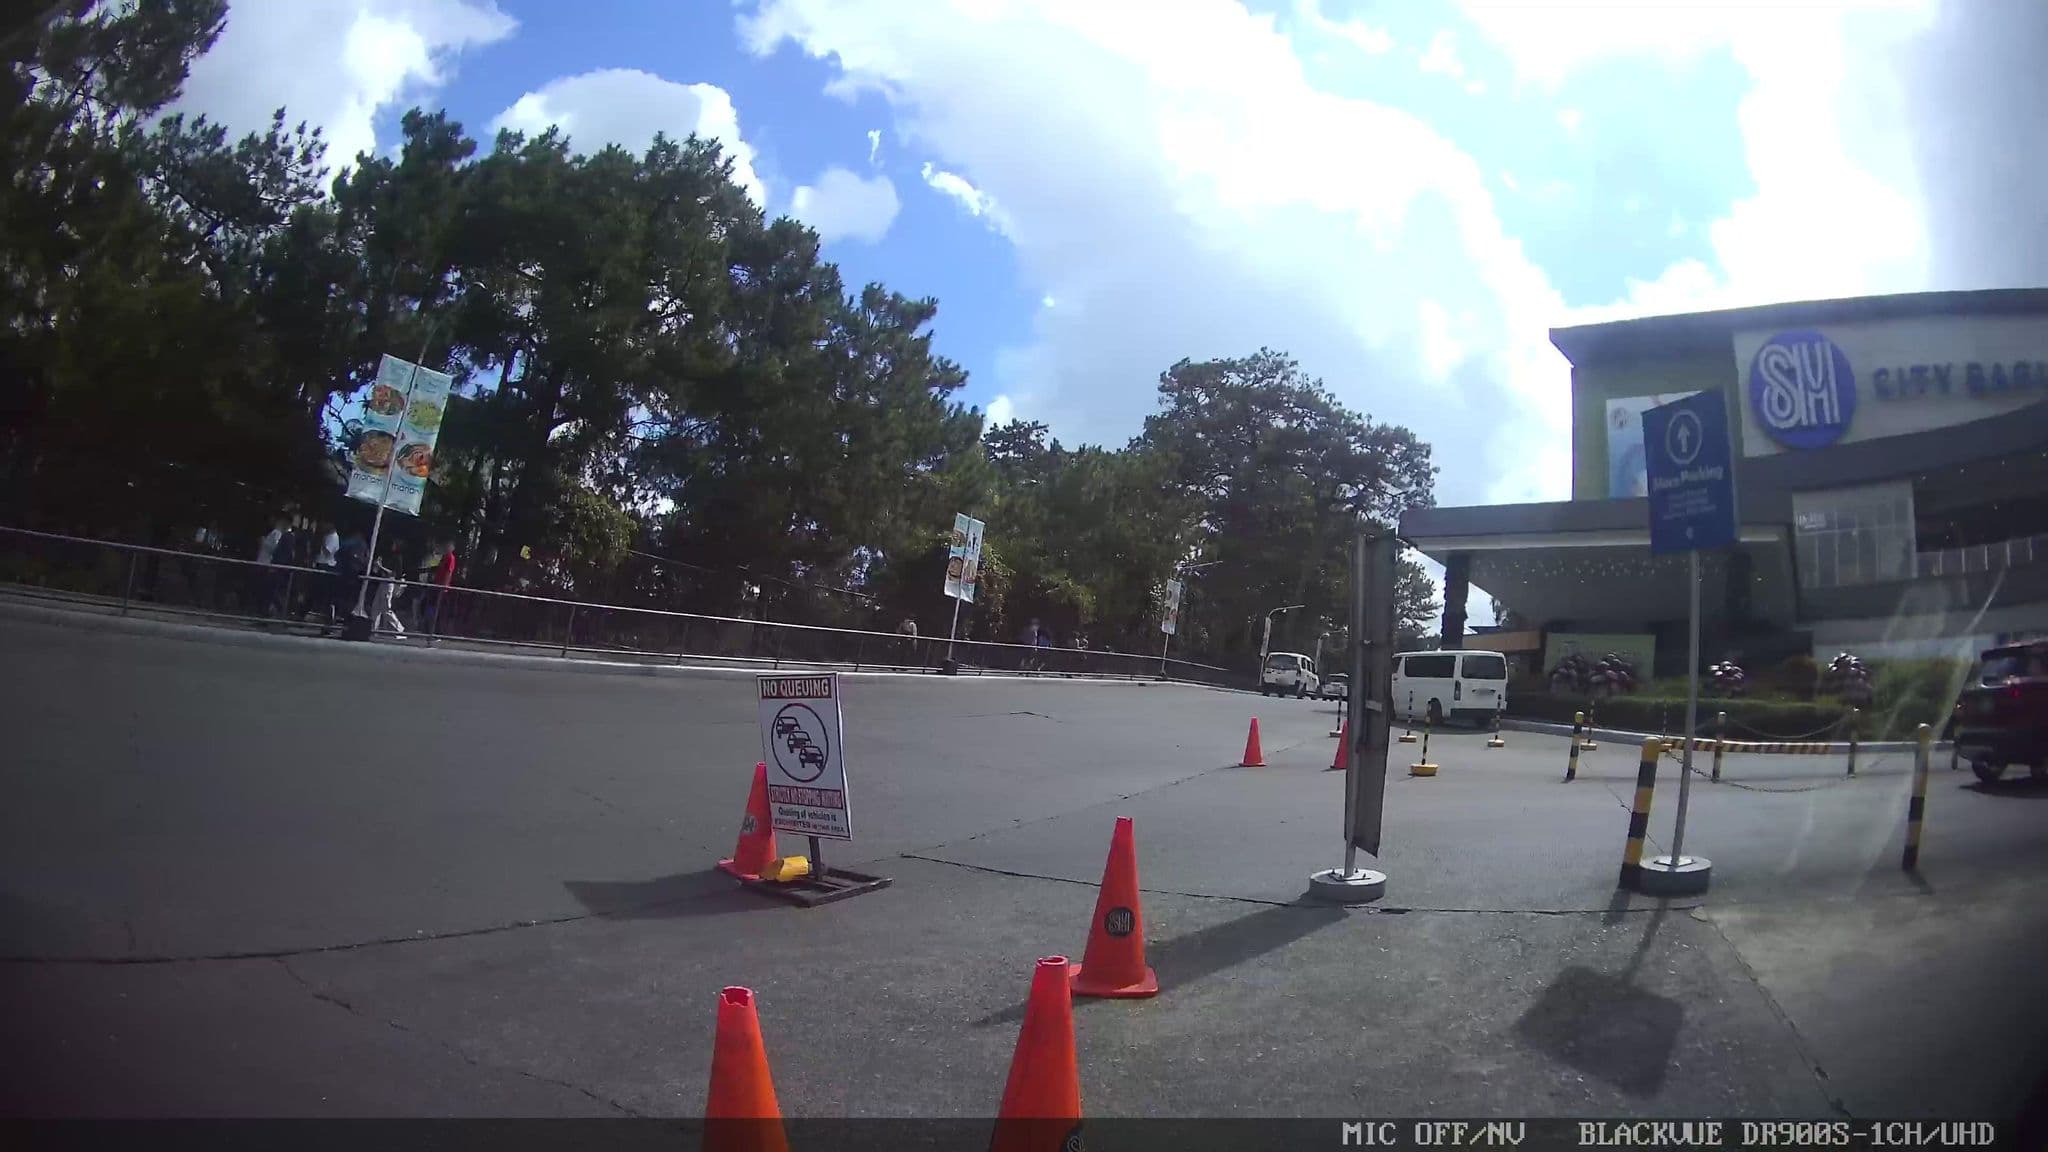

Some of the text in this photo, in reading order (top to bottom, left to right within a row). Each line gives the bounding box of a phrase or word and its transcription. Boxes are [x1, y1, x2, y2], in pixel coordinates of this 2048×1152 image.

[1759, 341, 1841, 429] SM
[1873, 363, 1951, 400] CITY
[763, 678, 829, 697] NO QUEUING
